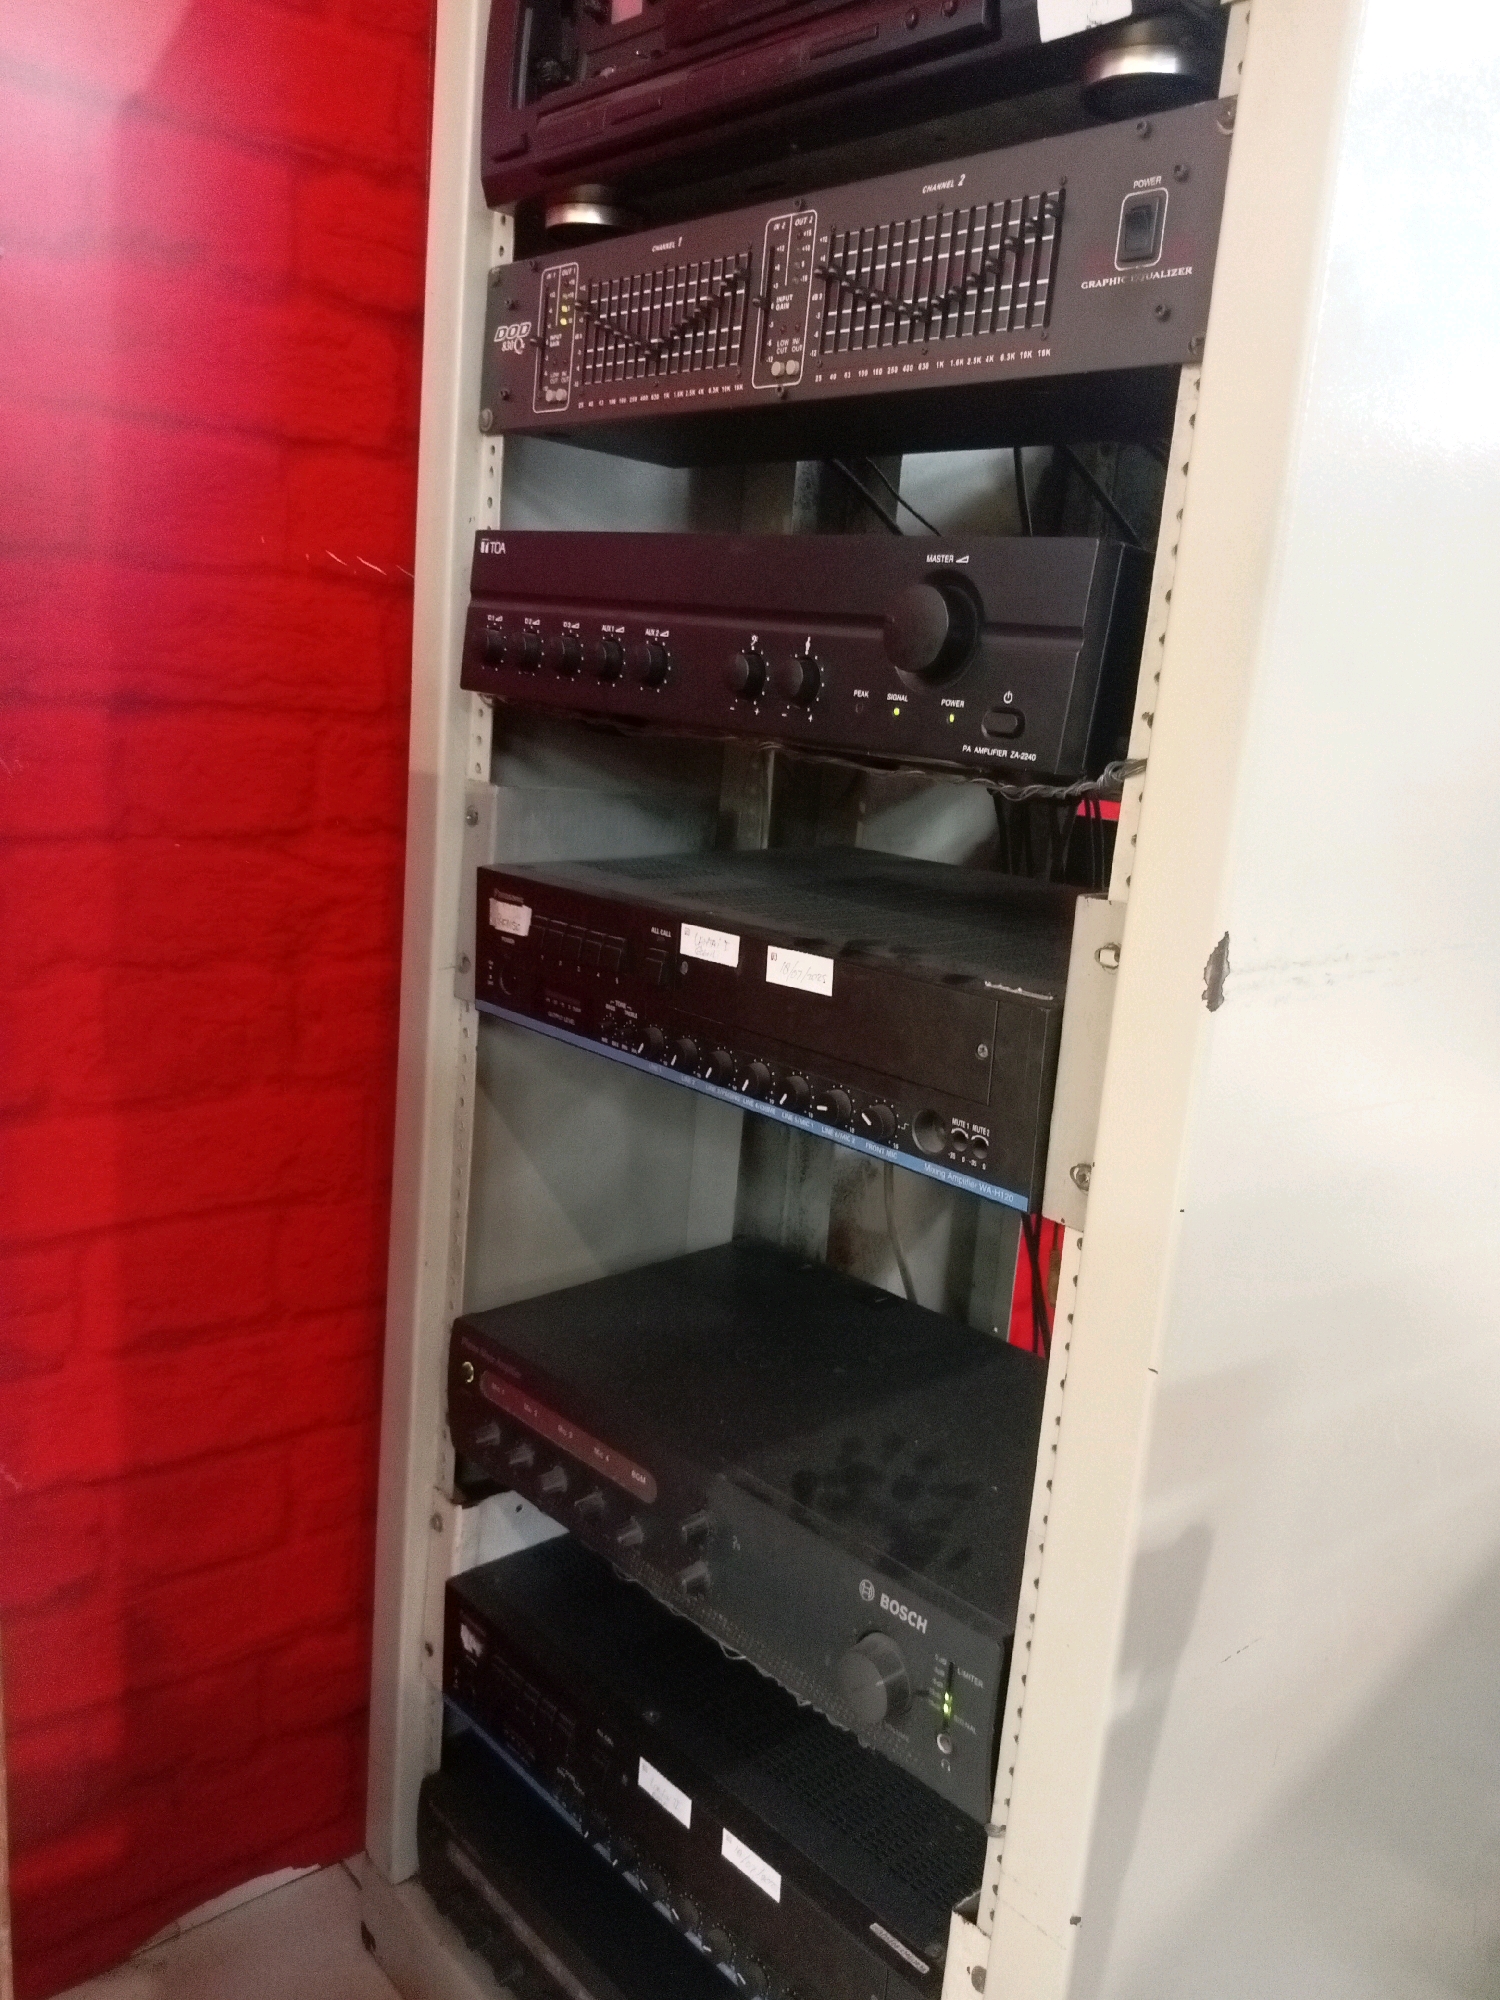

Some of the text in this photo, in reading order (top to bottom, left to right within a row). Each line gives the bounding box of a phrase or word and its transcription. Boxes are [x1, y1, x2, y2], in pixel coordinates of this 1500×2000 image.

[922, 174, 966, 194] CHANNEL 2
[1133, 176, 1162, 188] POWER
[776, 294, 793, 302] INPUT
[776, 302, 790, 311] GAIN
[494, 321, 532, 342] DOD
[777, 338, 789, 347] LOW
[926, 554, 954, 563] MASTER
[853, 690, 869, 698] PEAK
[887, 693, 908, 702] SIGNAL
[941, 699, 965, 708] POWER
[962, 745, 1037, 762] PA AMPLIFIER ZA-2240
[651, 926, 671, 937] ALL CALL
[782, 1112, 793, 1122] LINE
[952, 1117, 966, 1128] MUTE
[821, 1125, 834, 1136] LINE
[972, 1124, 986, 1135] MUTE
[865, 1142, 897, 1159] FRONT MIC
[924, 1162, 1014, 1202] Mixing Amplifier WA-H120
[880, 1593, 928, 1634] BOSCH
[957, 1667, 983, 1688] LIMITER
